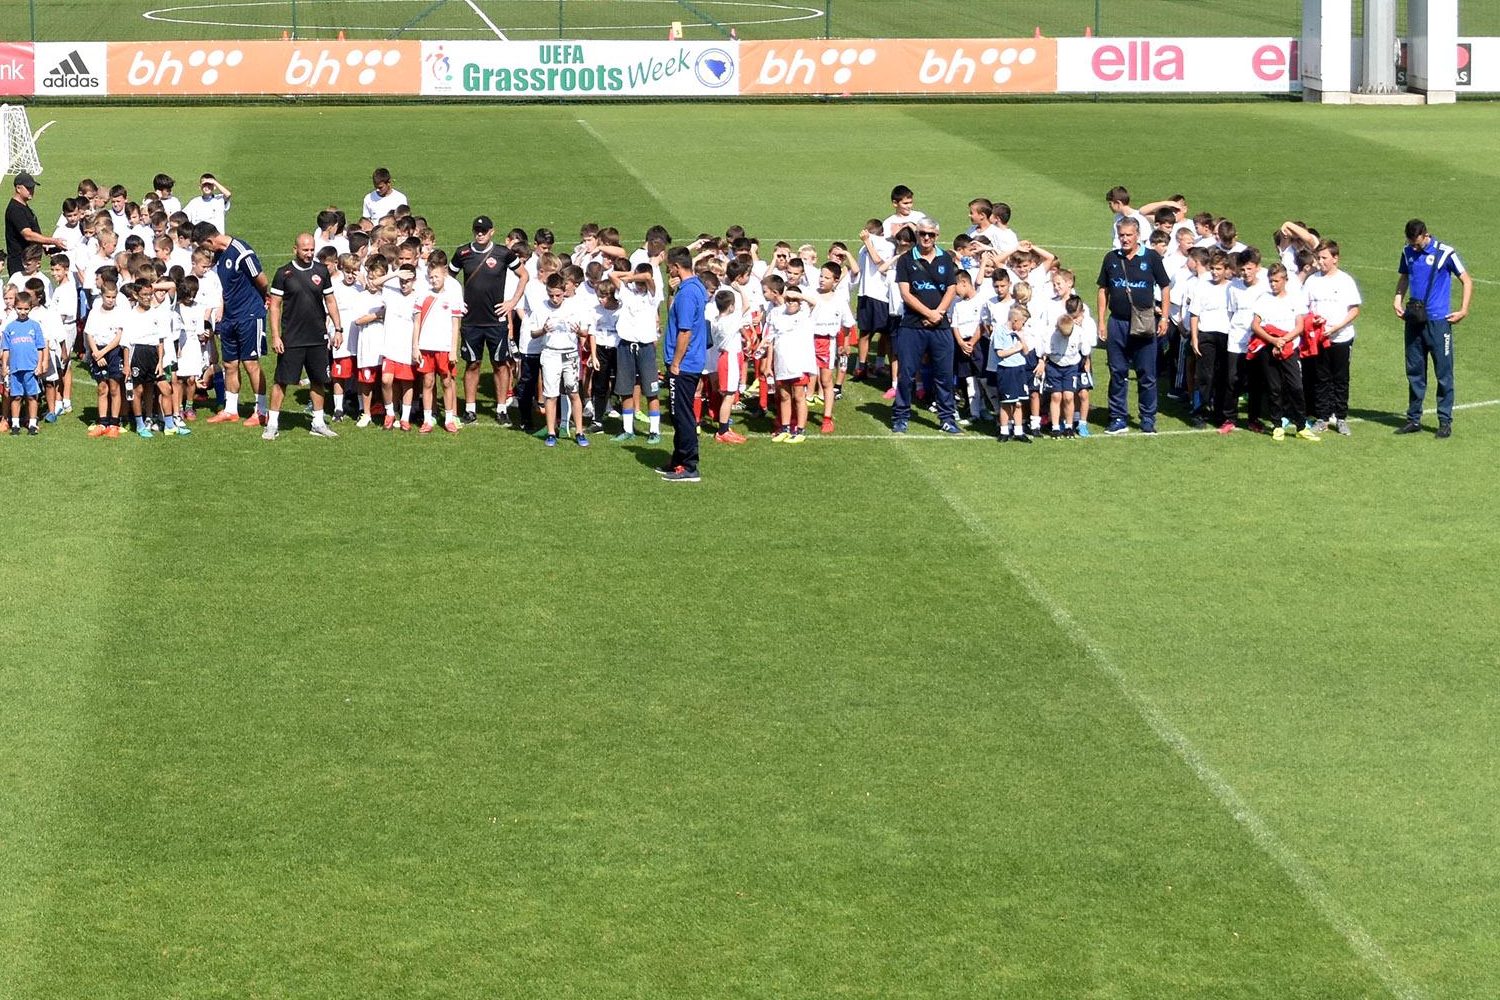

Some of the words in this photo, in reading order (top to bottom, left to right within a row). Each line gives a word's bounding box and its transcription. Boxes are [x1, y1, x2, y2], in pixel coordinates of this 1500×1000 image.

[127, 50, 184, 86] bh
[285, 50, 340, 86] bh
[462, 63, 623, 91] Grassroots
[627, 48, 691, 89] Week
[539, 45, 584, 64] UEFA
[758, 49, 816, 84] bh
[919, 49, 976, 84] bh
[1091, 41, 1184, 81] ella
[43, 74, 99, 88] adidas
